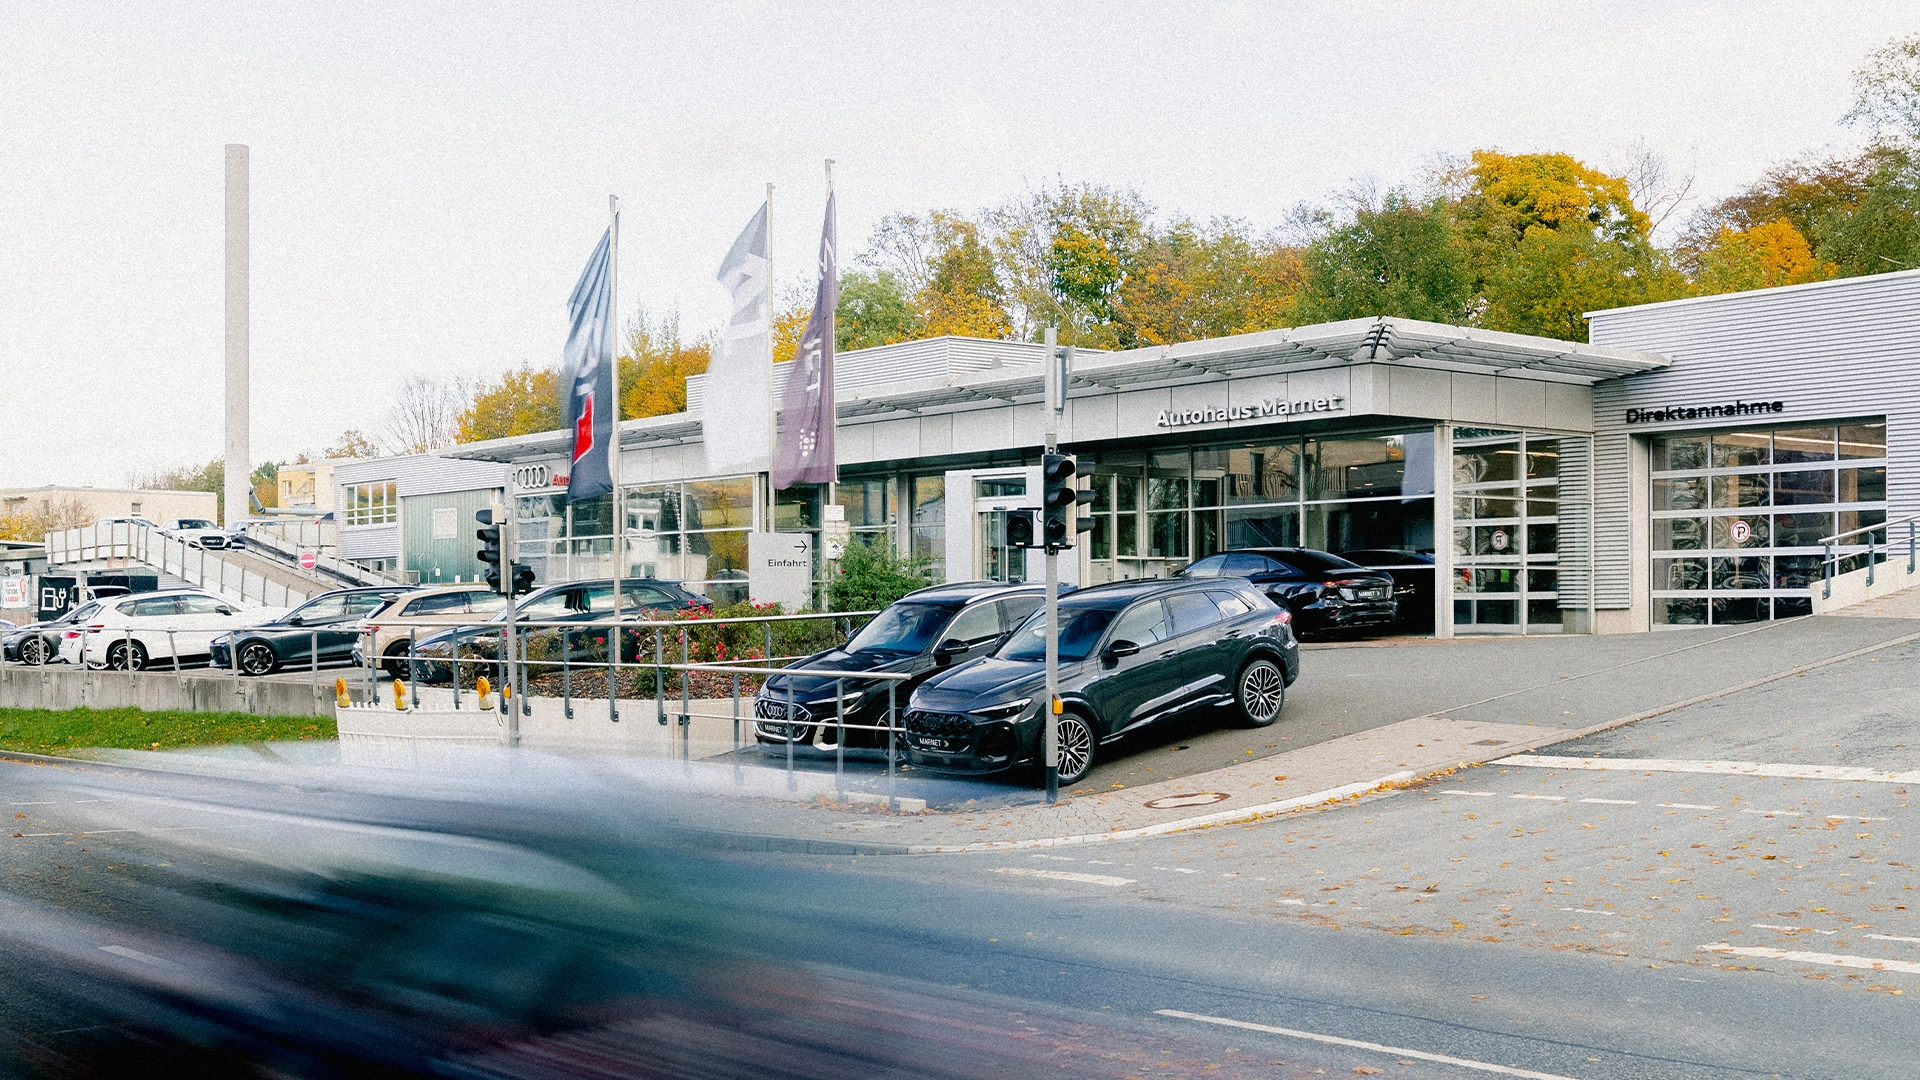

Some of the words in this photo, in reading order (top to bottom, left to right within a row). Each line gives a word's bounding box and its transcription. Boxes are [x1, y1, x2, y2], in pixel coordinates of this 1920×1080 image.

[1155, 405, 1252, 427] Autohaus
[1257, 395, 1344, 417] Marnet
[1626, 400, 1783, 423] Direktannahme
[552, 473, 571, 486] Aud
[767, 558, 808, 568] Einfahrt
[919, 737, 942, 747] MARNET
